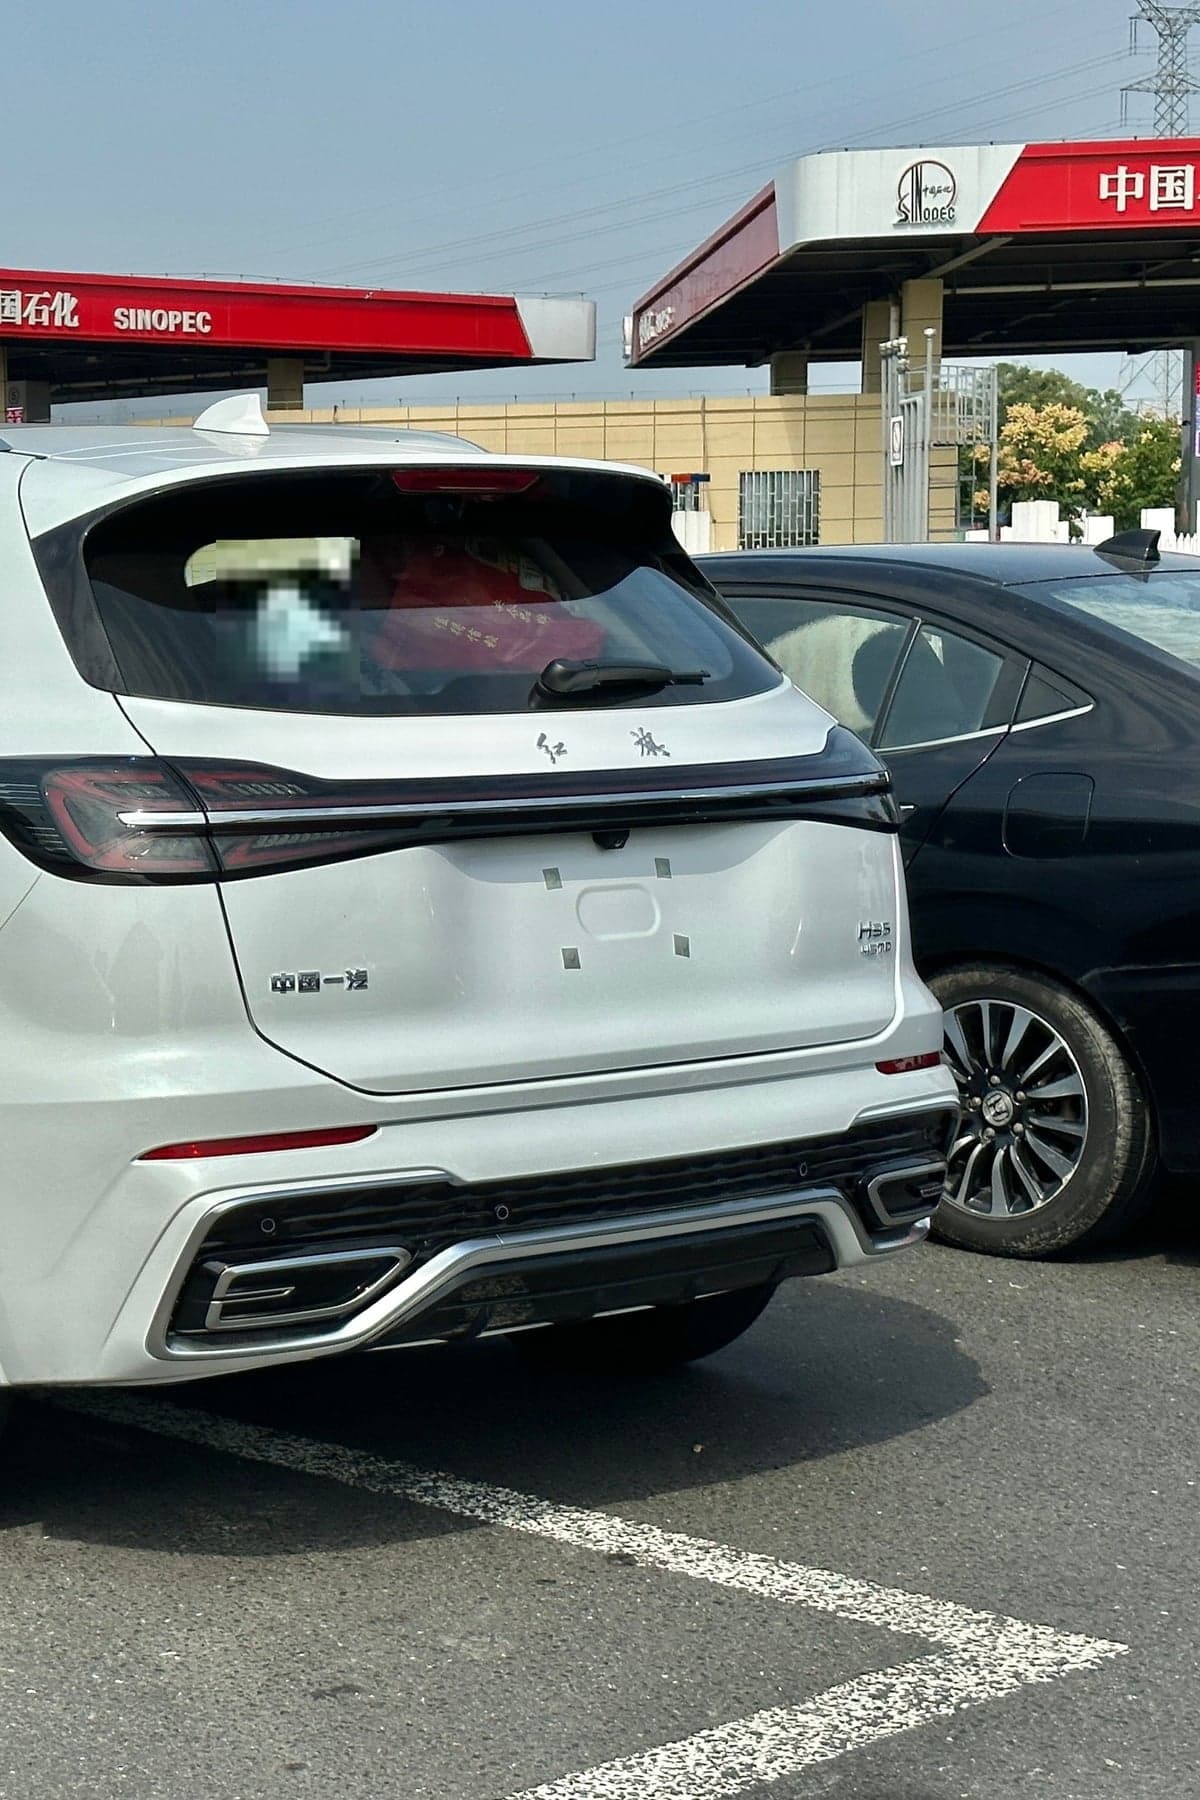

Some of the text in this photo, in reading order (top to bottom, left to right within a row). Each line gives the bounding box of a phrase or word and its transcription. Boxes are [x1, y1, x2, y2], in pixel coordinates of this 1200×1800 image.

[1099, 164, 1200, 212] 中国
[113, 306, 213, 334] SINOPEC
[270, 967, 369, 994] 中国一汽
